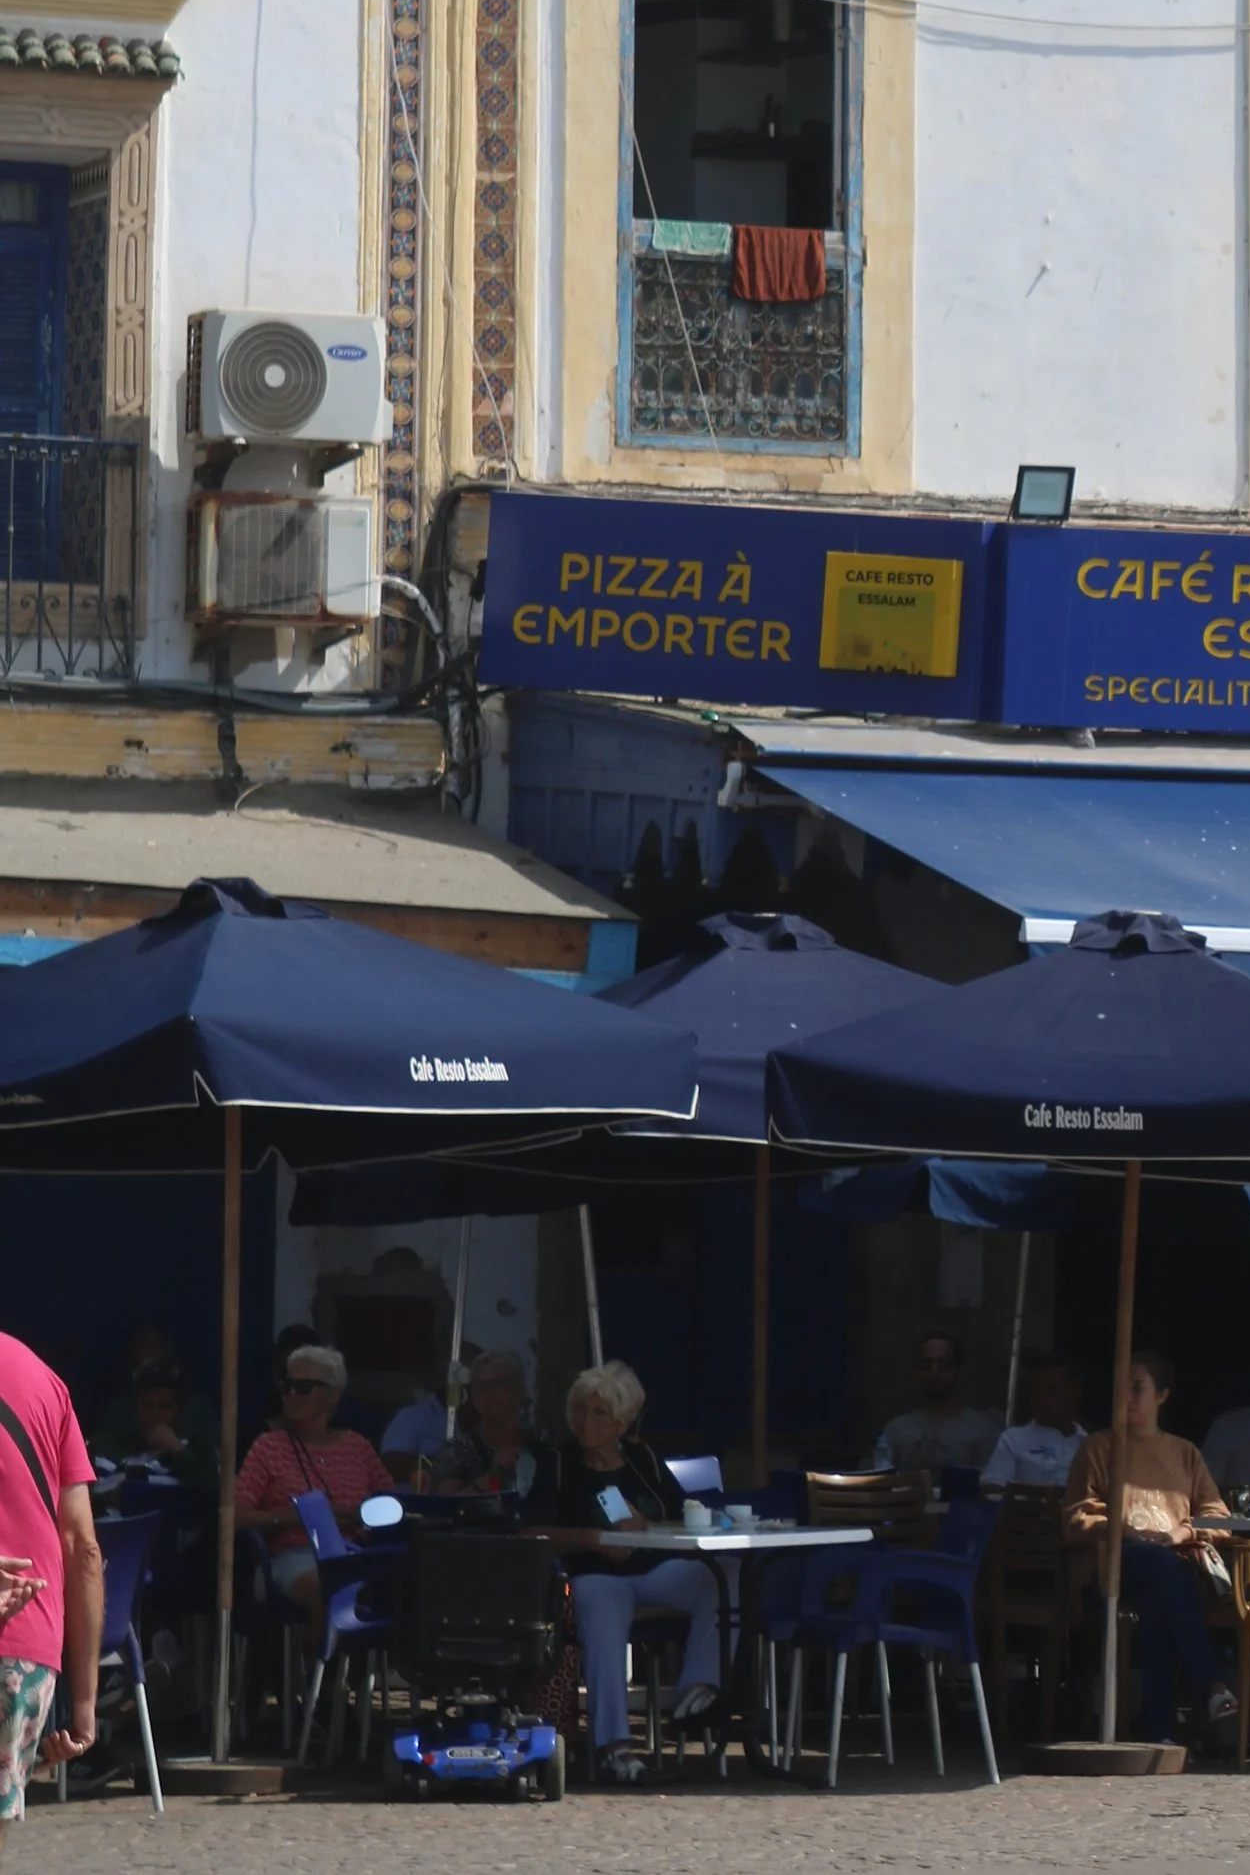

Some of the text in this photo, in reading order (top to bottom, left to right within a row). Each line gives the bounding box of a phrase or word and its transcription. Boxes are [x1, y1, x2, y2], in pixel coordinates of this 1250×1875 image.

[560, 550, 752, 605] PIZZA À
[845, 570, 935, 586] CAFE RESTO
[1077, 550, 1215, 603] CAFÉ
[857, 593, 916, 608] ESSALAM
[512, 604, 792, 662] EMPORTER
[434, 1057, 466, 1082] Resto
[464, 1056, 510, 1082] Essalam
[1056, 1105, 1091, 1129] Resto
[1094, 1105, 1143, 1131] Essalam
